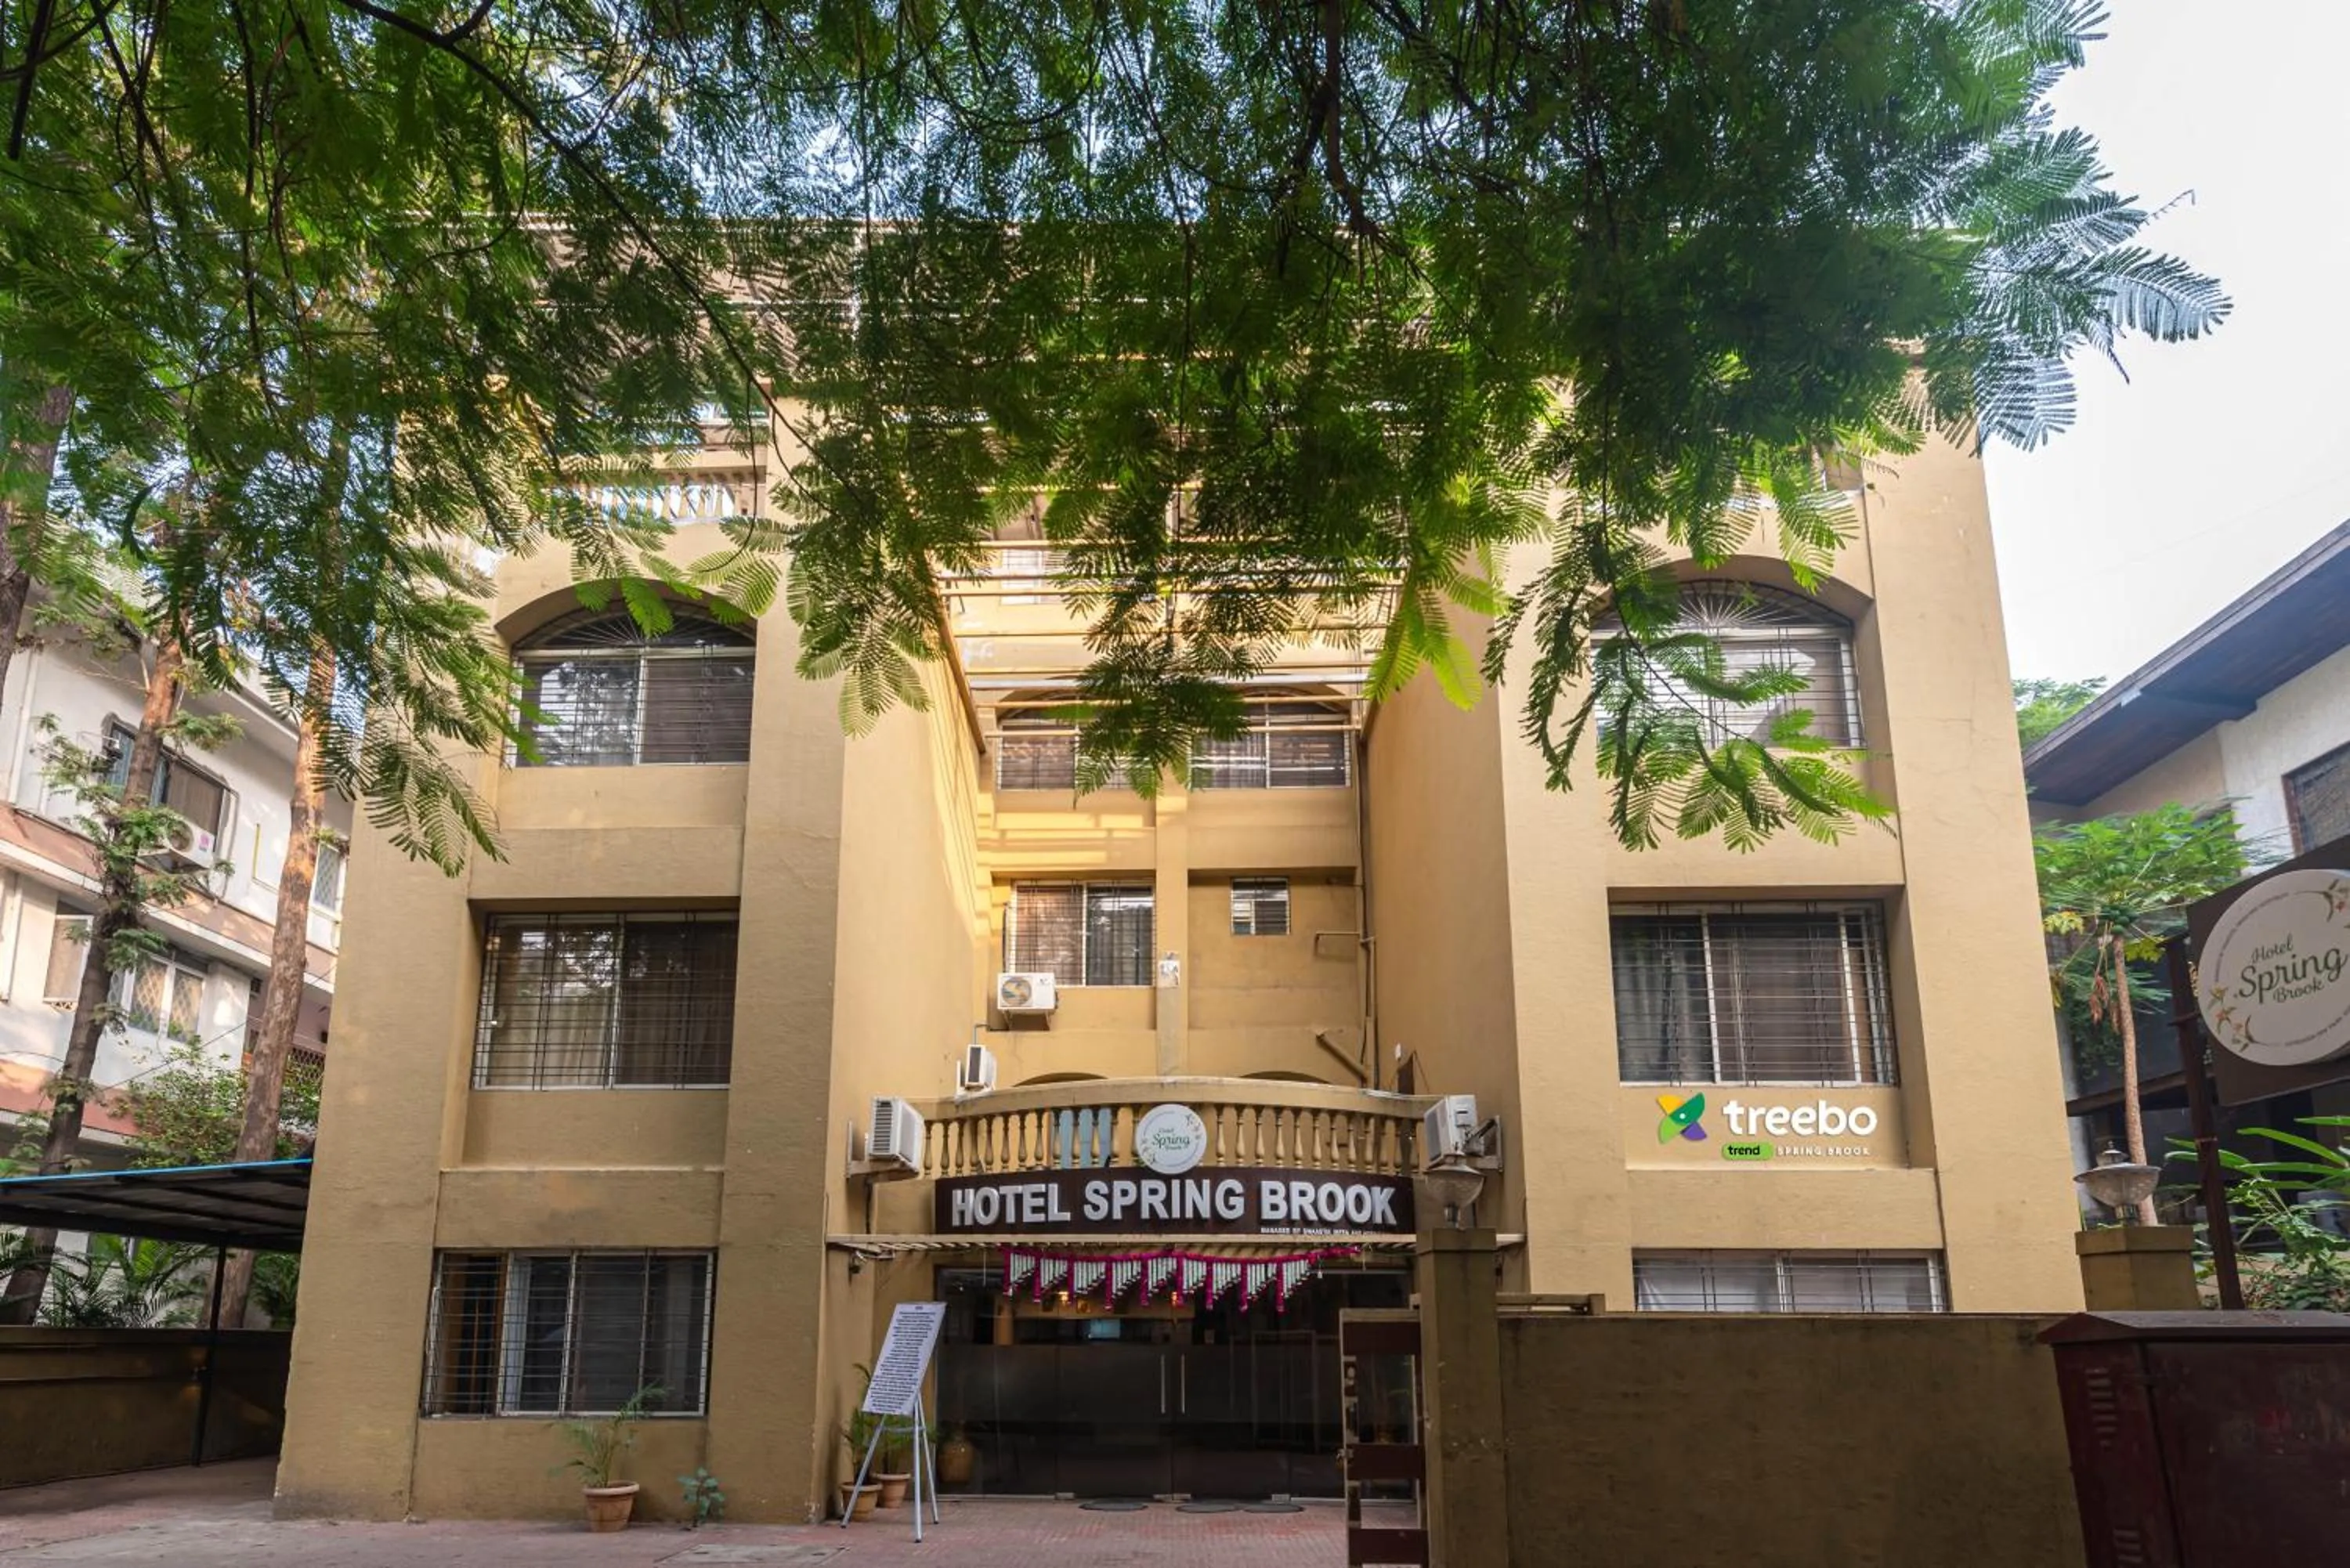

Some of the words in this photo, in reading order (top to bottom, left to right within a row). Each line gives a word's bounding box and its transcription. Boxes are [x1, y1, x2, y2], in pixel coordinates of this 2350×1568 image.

[2251, 932, 2293, 963] Hotel
[2239, 948, 2348, 1004] Spring
[2273, 977, 2324, 1003] Brook
[1723, 1100, 1878, 1135] treebo
[1152, 1133, 1190, 1149] Spring
[1728, 1145, 1761, 1156] trend
[1777, 1146, 1822, 1156] SPRING
[1828, 1146, 1870, 1156] BROOK
[952, 1183, 1071, 1227] HOTEL
[1083, 1179, 1244, 1221] SPRING
[1260, 1180, 1396, 1225] BROOK
